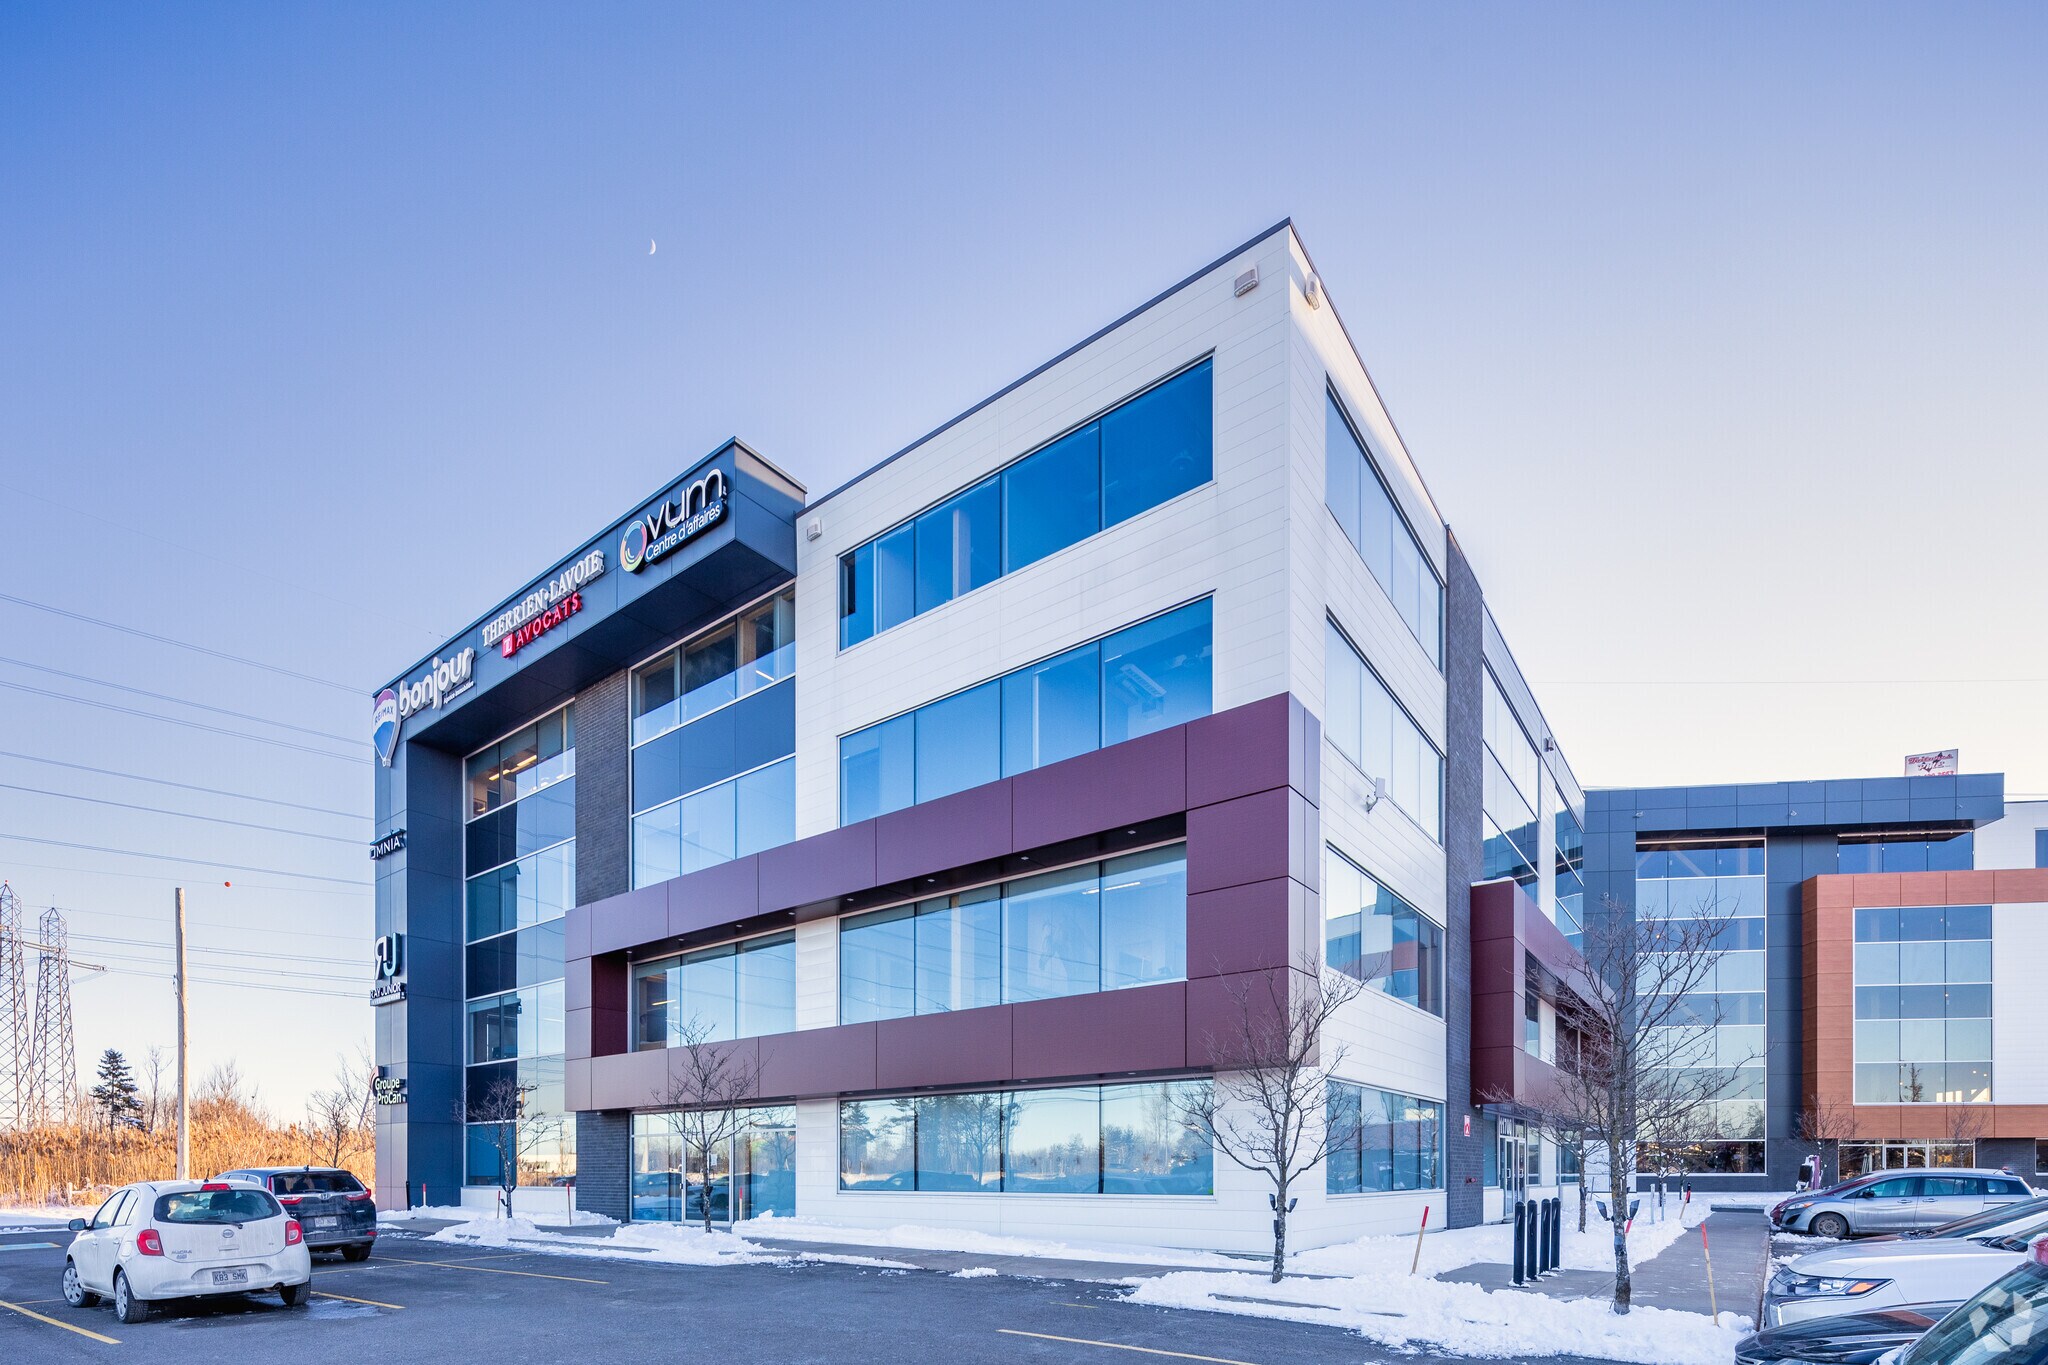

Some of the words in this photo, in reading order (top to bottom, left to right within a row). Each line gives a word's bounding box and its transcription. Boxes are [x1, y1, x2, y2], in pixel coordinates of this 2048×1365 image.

[645, 533, 677, 560] Centre
[678, 501, 721, 541] d'affaires
[516, 592, 581, 648] AVOCATS
[399, 647, 475, 718] bonjour
[375, 706, 394, 726] RE/MAX
[369, 836, 401, 859] OMNIA
[375, 1078, 400, 1092] Groupe
[378, 1091, 402, 1105] ProCan
